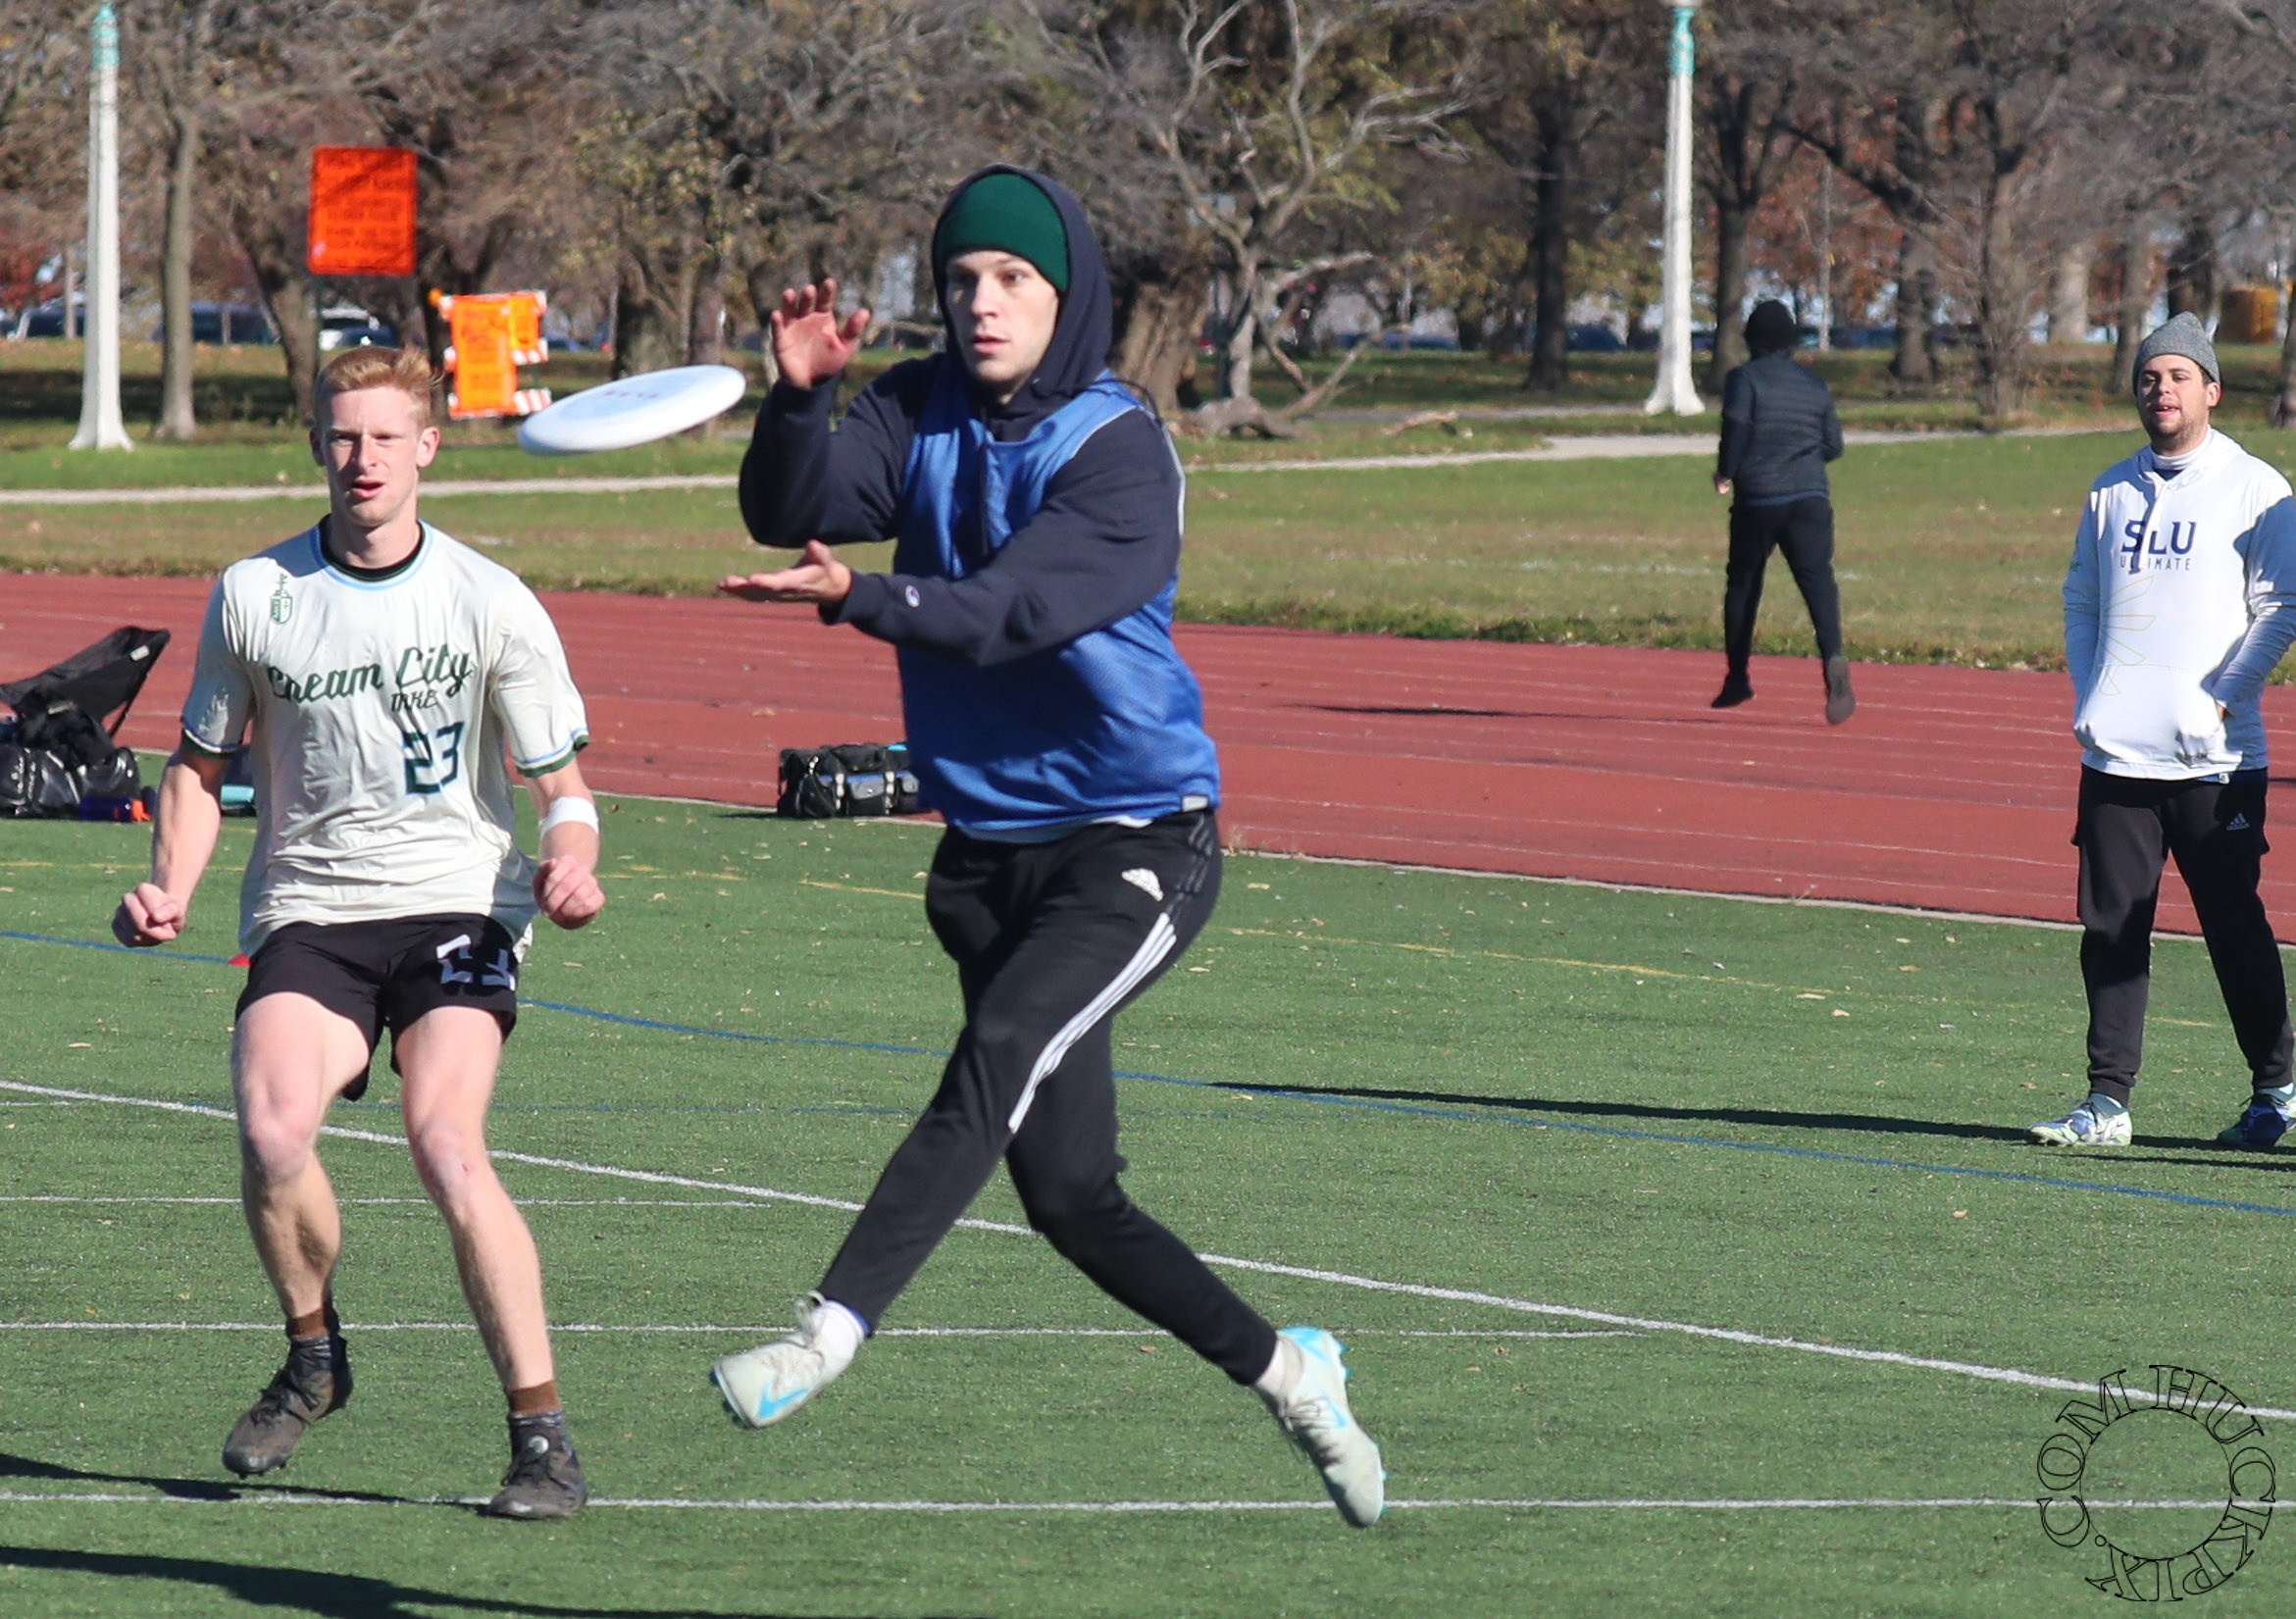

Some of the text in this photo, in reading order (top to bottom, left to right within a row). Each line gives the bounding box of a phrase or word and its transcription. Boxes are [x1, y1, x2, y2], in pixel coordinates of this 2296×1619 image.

[2120, 520, 2197, 555] SLU
[2119, 556, 2191, 571] UIMATE
[268, 644, 473, 704] Cream City
[403, 721, 465, 796] 23
